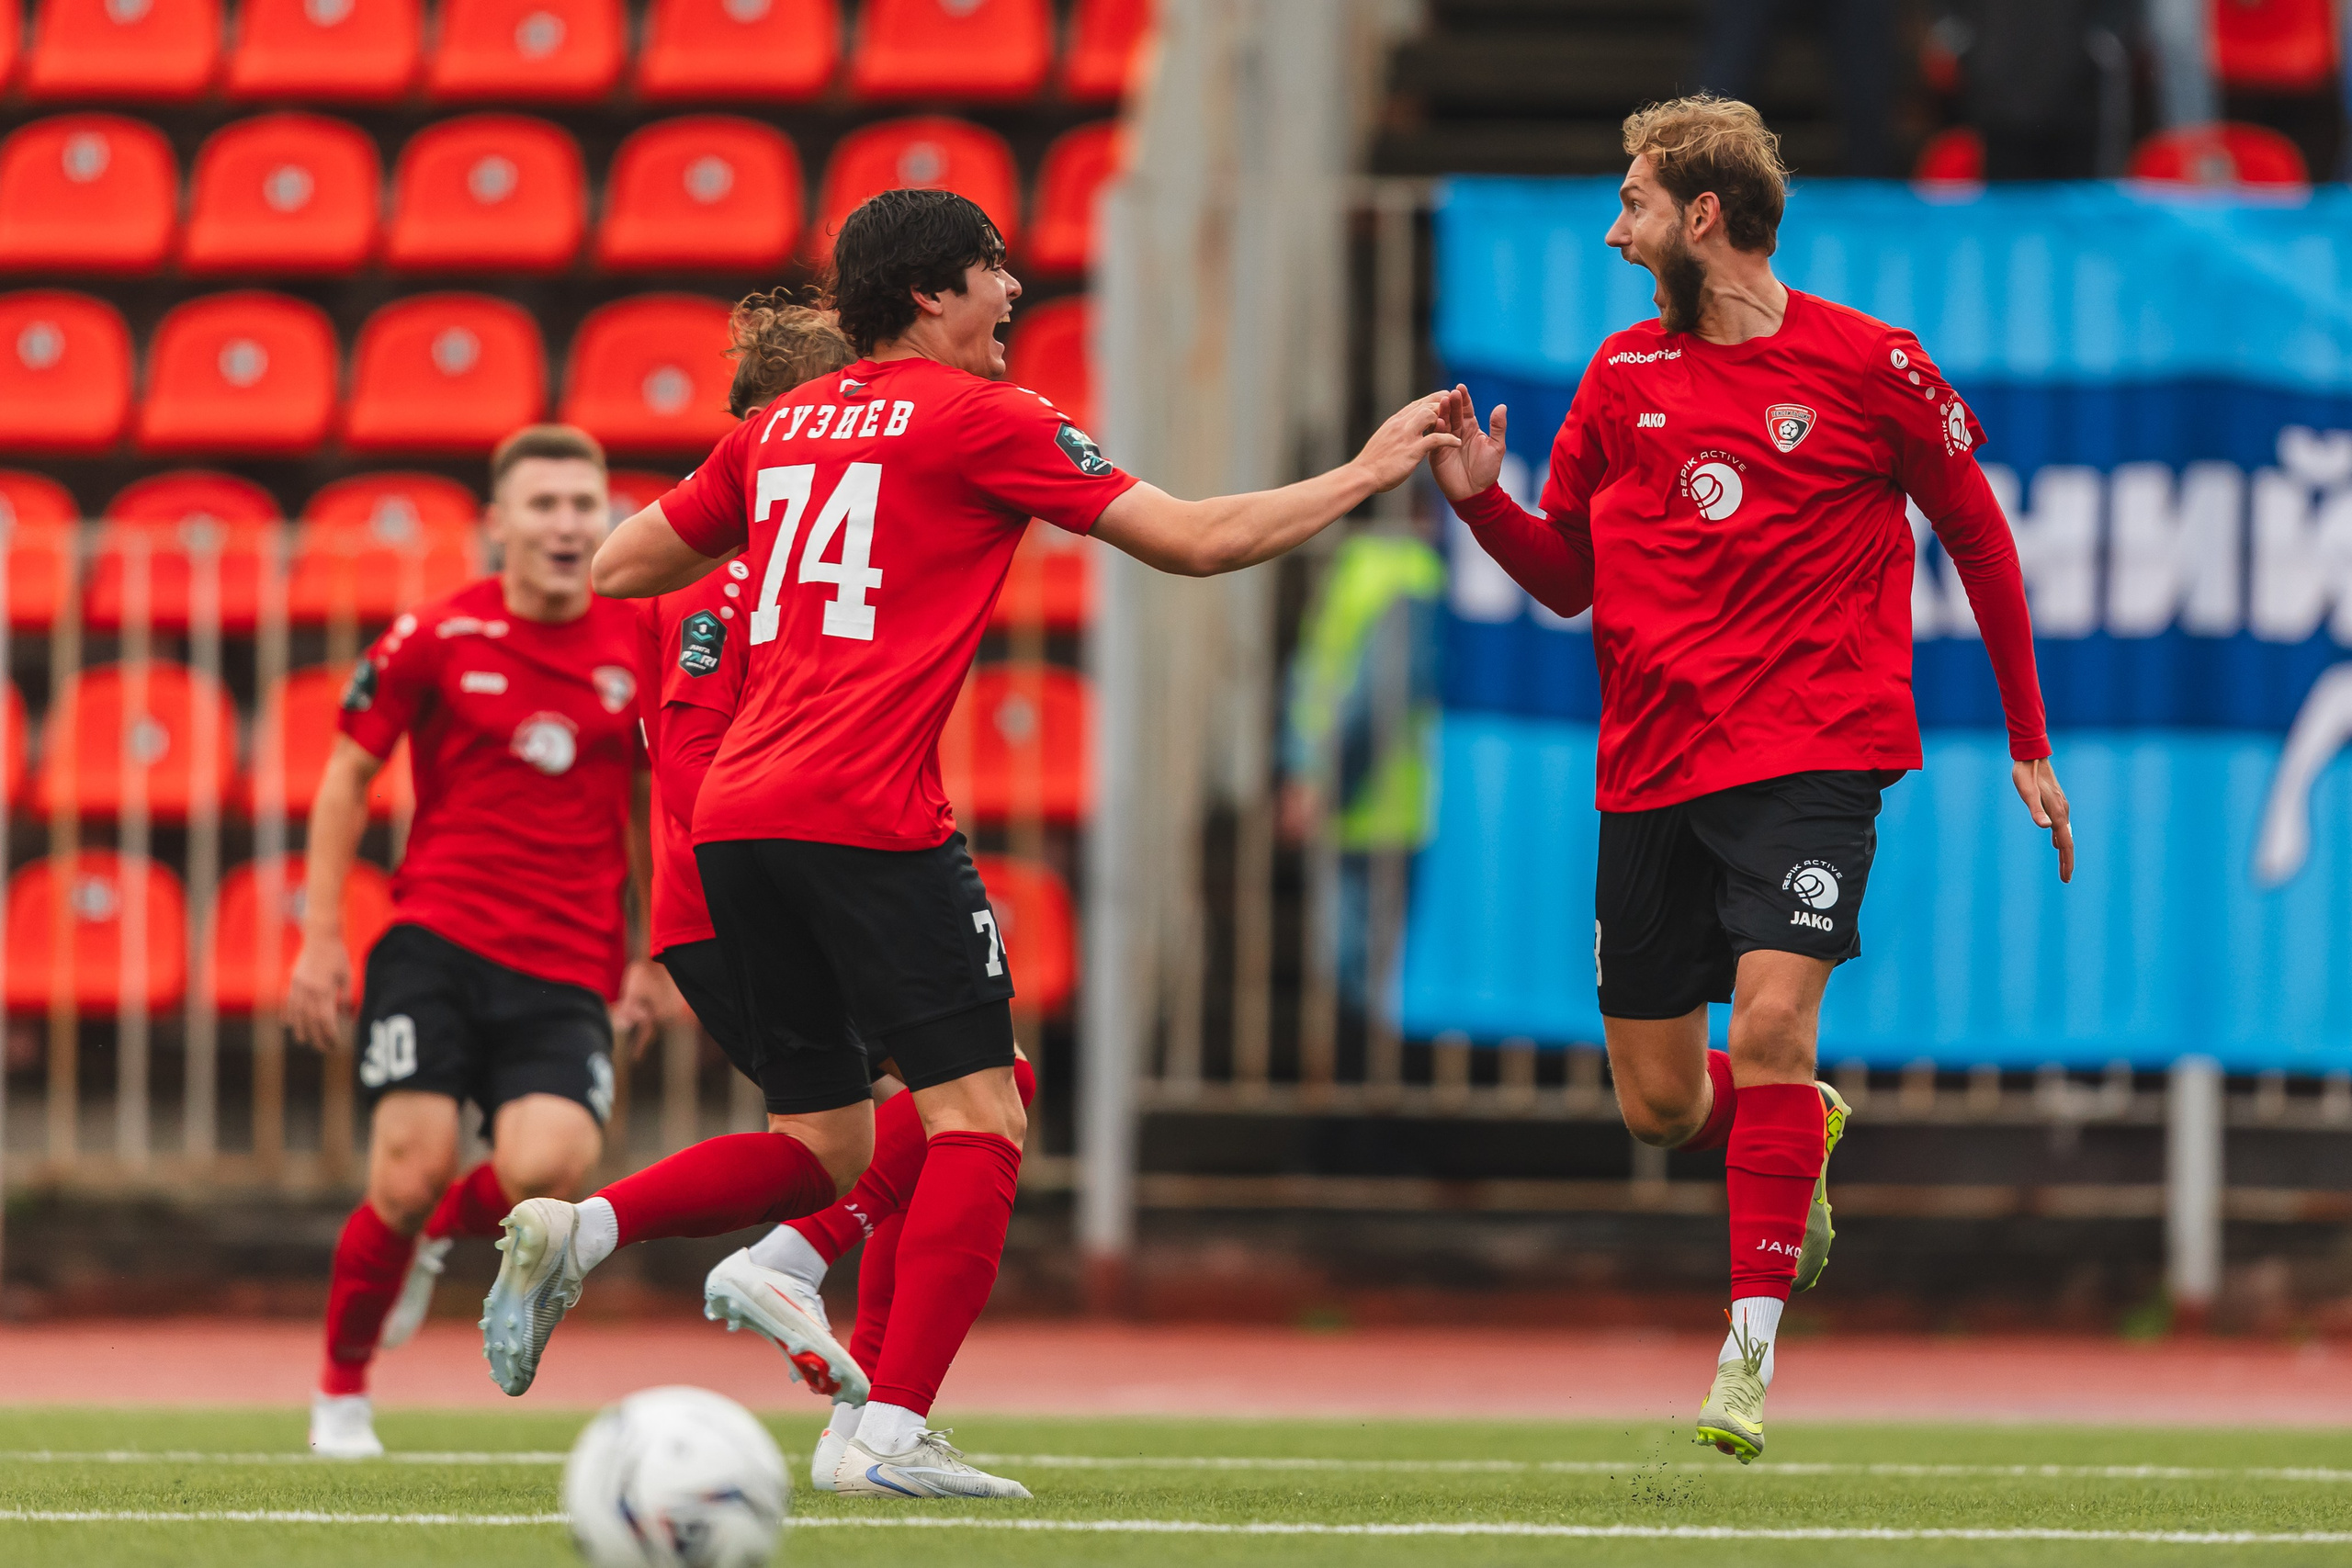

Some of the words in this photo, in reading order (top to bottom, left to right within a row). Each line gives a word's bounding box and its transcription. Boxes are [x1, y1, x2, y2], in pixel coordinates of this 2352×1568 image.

[1608, 349, 1682, 366] wildberries
[760, 399, 915, 445] ГУЗИЕВ
[1636, 412, 1667, 428] JAKO
[1679, 457, 1699, 497] REPIK
[1700, 450, 1747, 472] ACTIVE
[749, 461, 884, 647] 74
[1782, 863, 1802, 890] REPIK
[1804, 859, 1843, 879] ACTIVE
[1790, 910, 1834, 932] JAKO
[971, 909, 1007, 978] 7
[1756, 1238, 1803, 1259] JAKO
